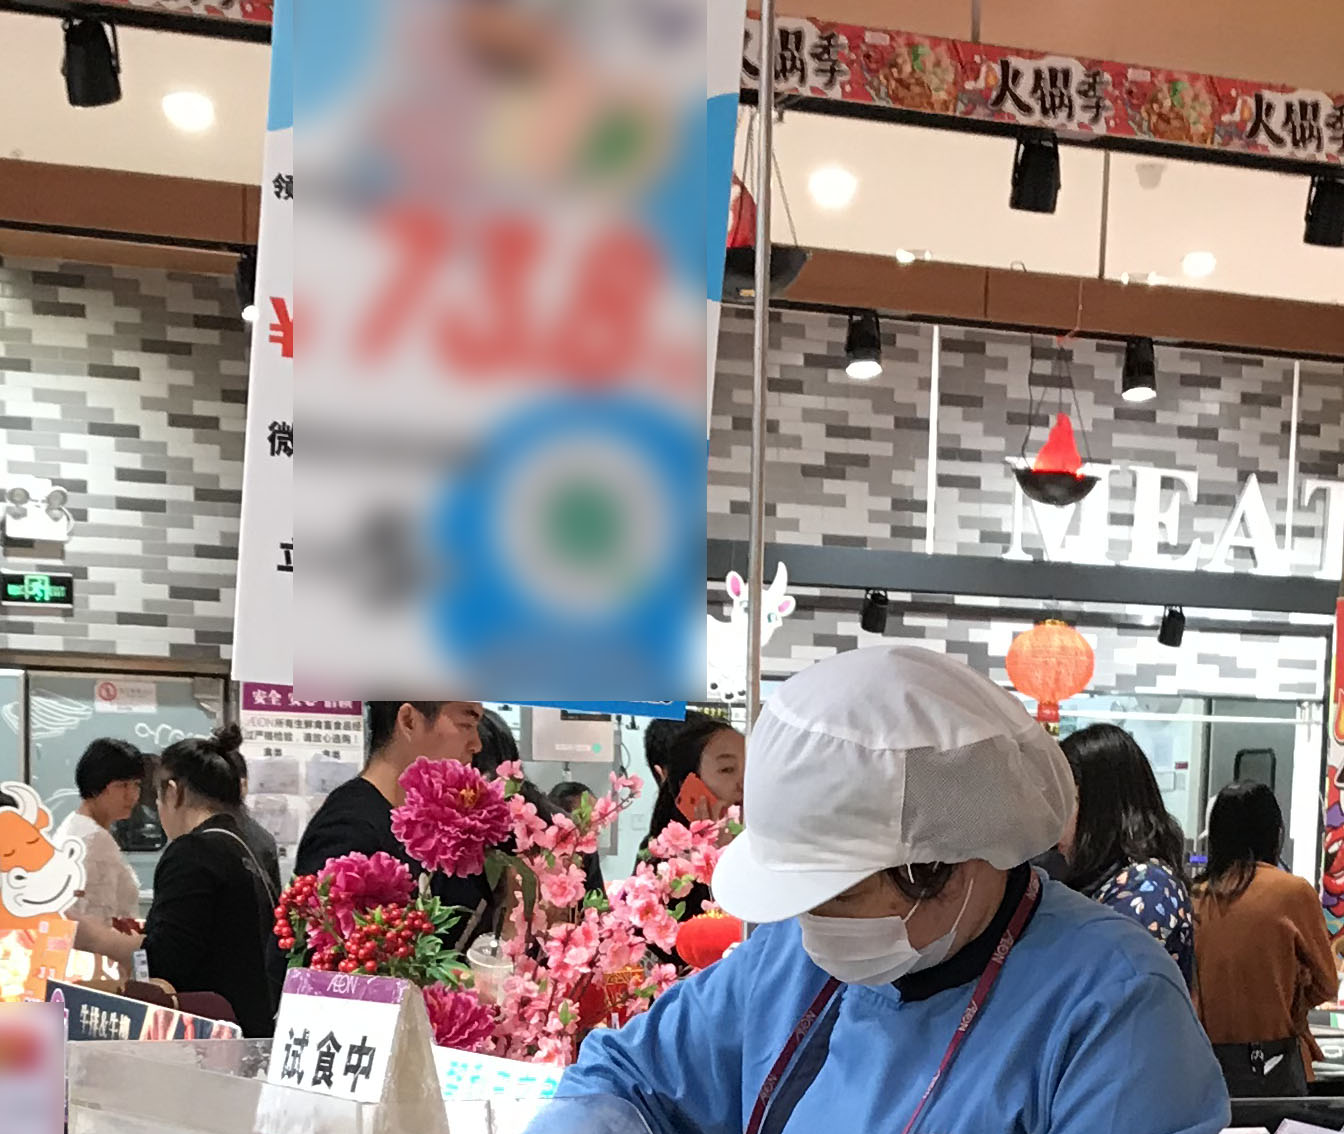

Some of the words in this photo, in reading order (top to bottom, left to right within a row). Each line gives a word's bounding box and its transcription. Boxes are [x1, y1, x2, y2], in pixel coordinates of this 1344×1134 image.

[989, 58, 1109, 124] 火锅季
[252, 689, 282, 706] 安全
[281, 1027, 376, 1093] 试食中
